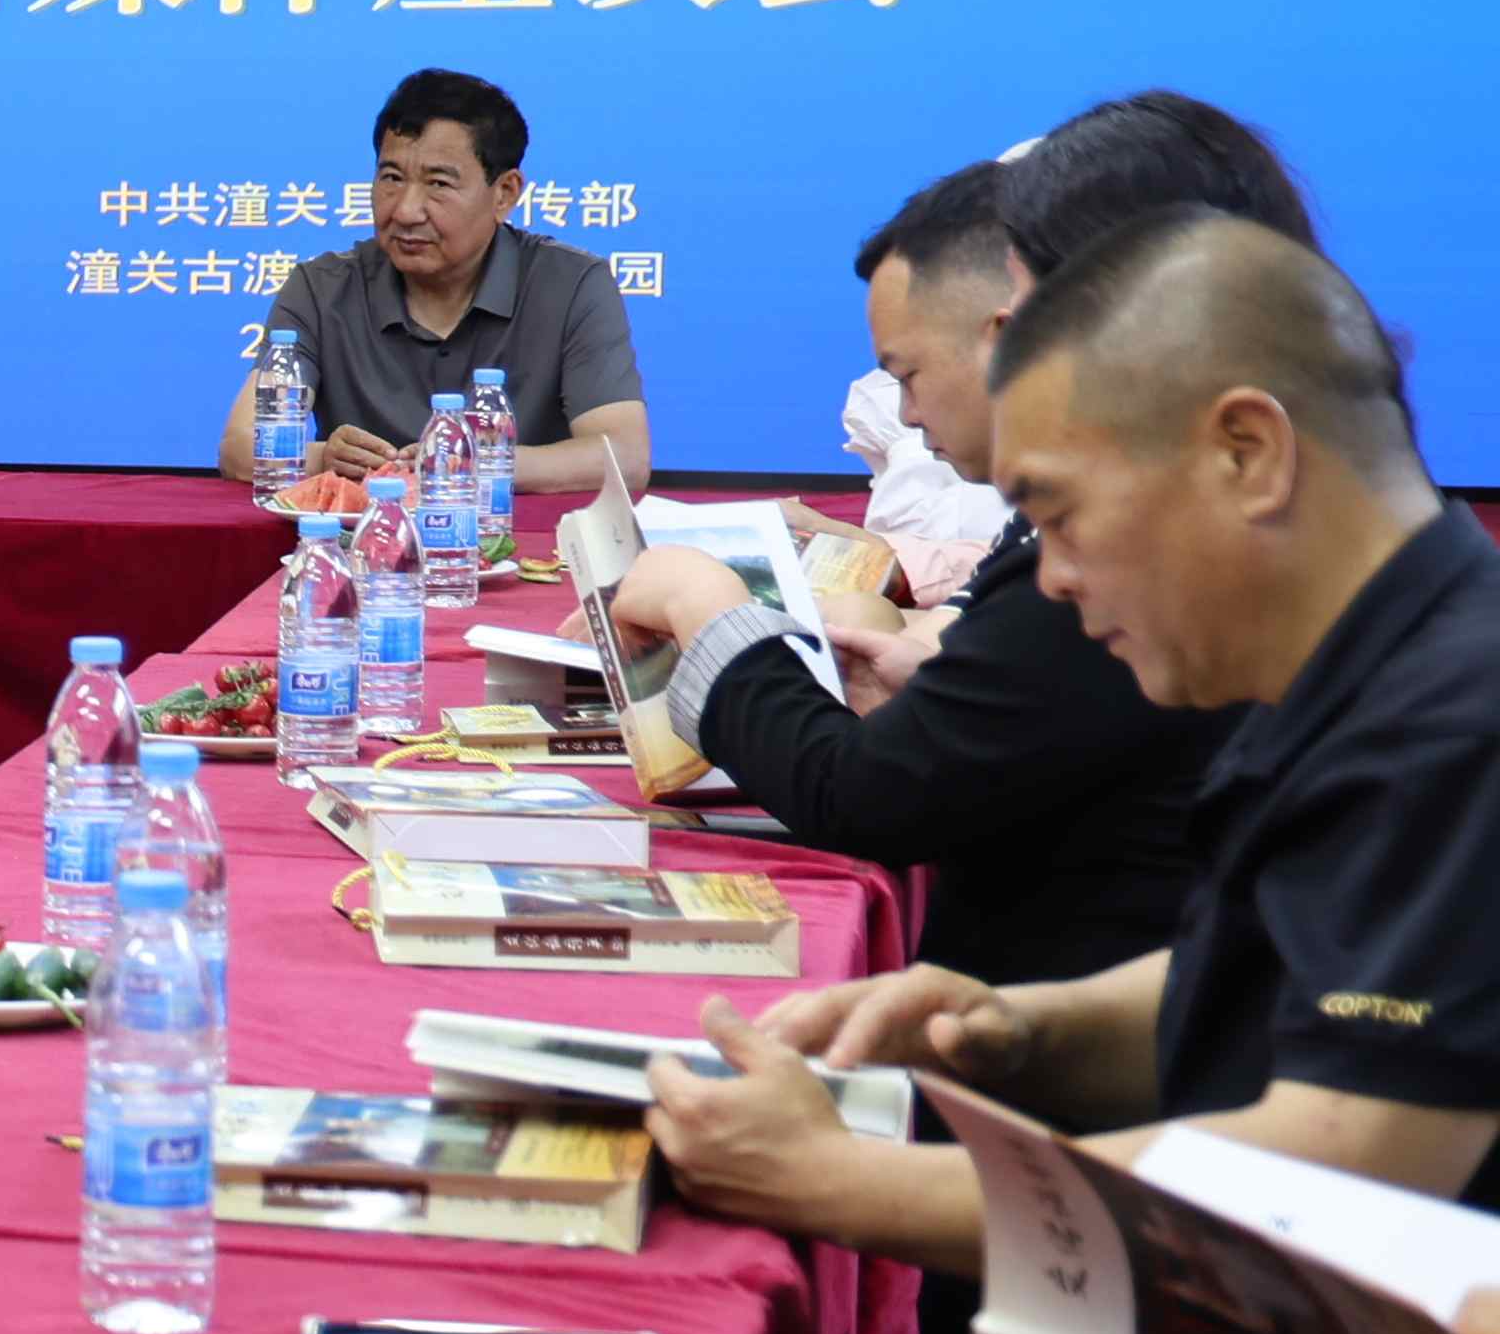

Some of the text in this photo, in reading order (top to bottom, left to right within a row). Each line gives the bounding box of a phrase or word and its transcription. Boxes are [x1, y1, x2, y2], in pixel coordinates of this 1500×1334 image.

[100, 180, 638, 228] 中共潼关县传部
